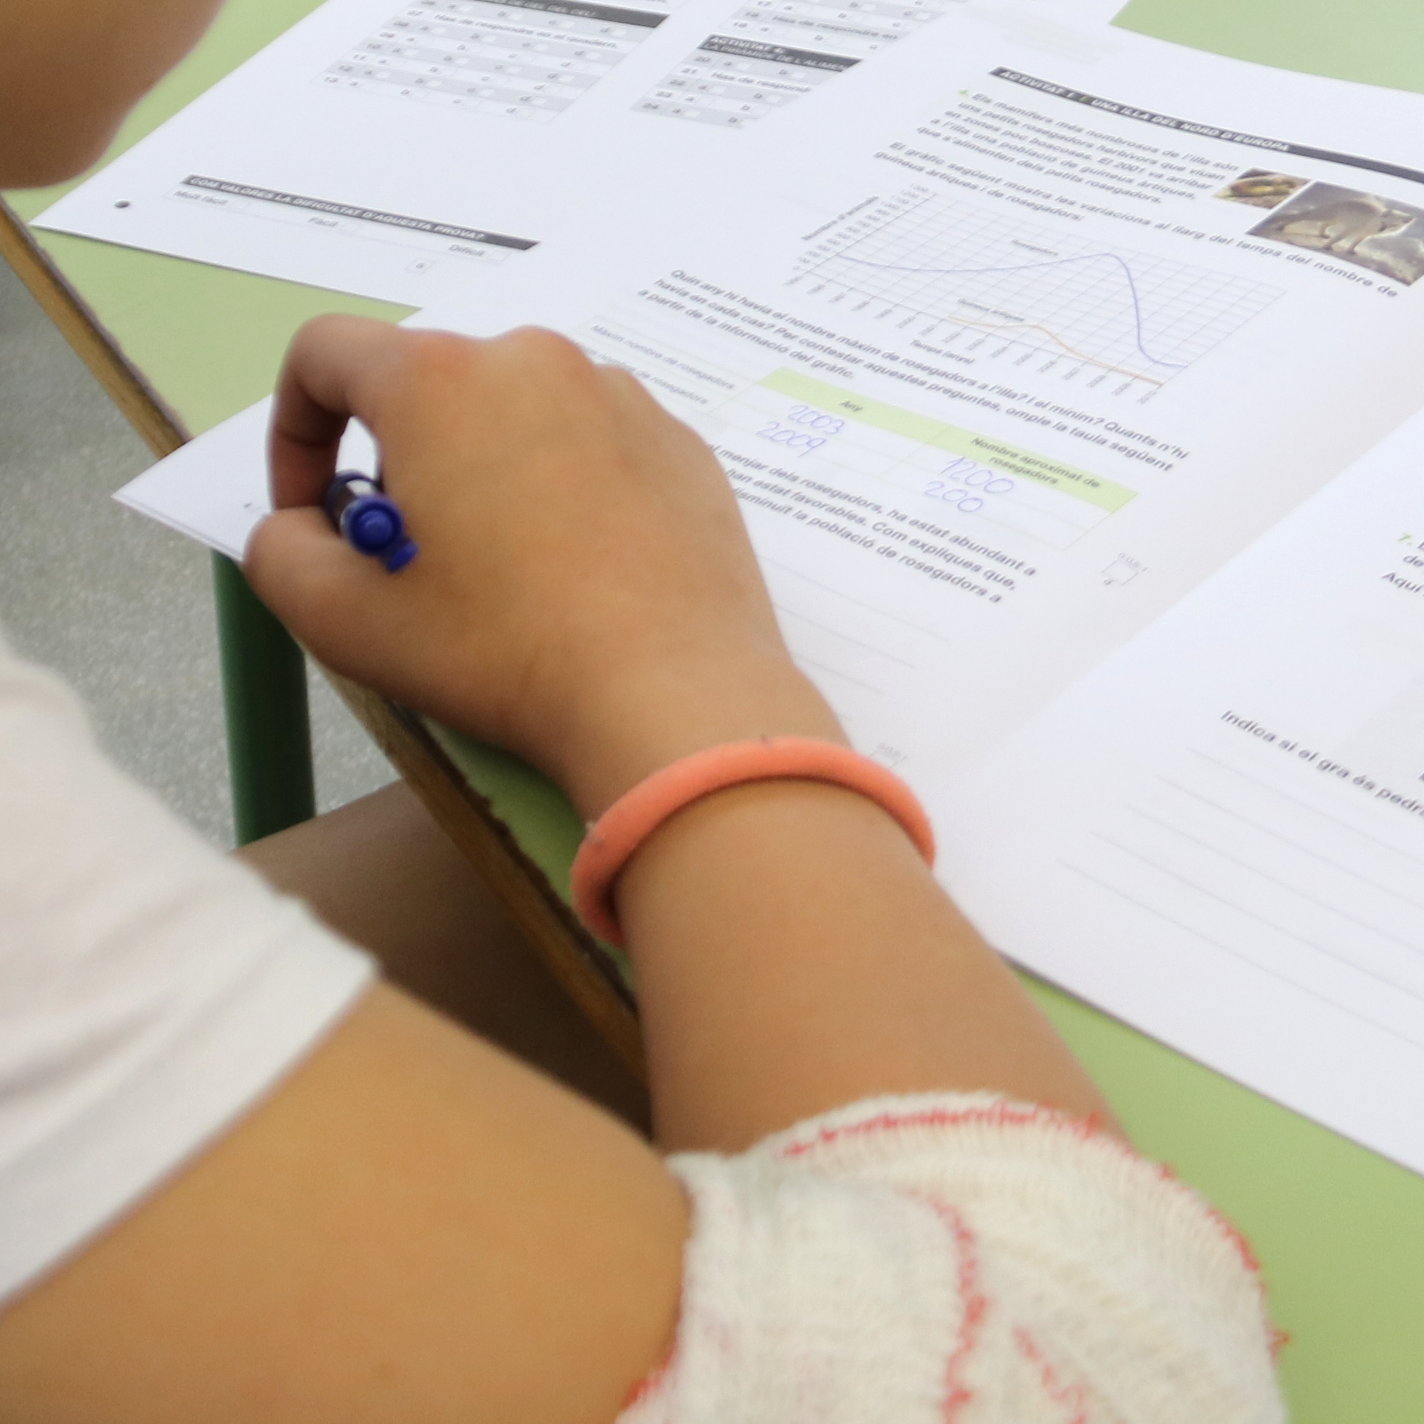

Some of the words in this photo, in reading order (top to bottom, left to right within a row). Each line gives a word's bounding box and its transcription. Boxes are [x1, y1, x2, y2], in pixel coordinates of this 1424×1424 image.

[788, 404, 845, 435] 2003
[839, 399, 863, 413] Any
[755, 421, 826, 458] 2009
[940, 456, 1014, 494] 1200
[923, 480, 984, 513] 200
[1220, 709, 1277, 743] Indica
[1277, 739, 1298, 752] si
[1297, 749, 1319, 762] el
[1317, 758, 1350, 779] gra
